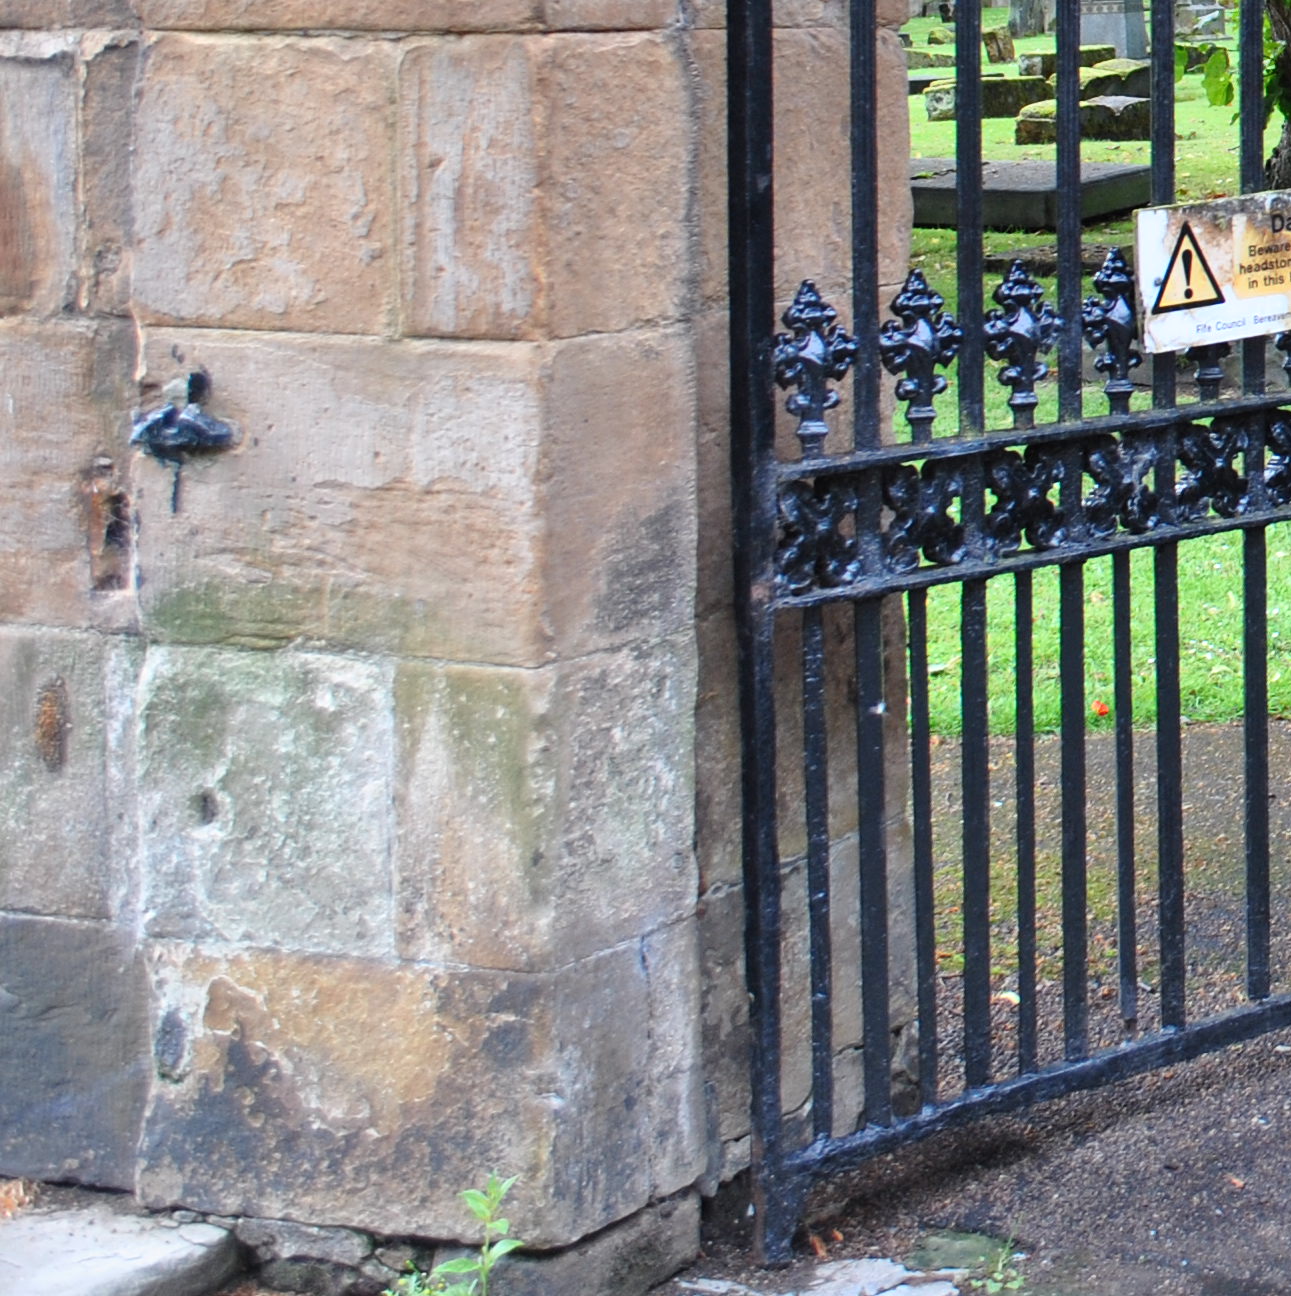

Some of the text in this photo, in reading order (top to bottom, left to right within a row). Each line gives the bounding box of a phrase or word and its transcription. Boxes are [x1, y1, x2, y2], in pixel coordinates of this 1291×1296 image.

[1248, 243, 1291, 257] Beware
[1248, 277, 1258, 289] in
[1263, 273, 1285, 287] this
[1196, 324, 1212, 334] Fife
[1215, 317, 1246, 332] Council
